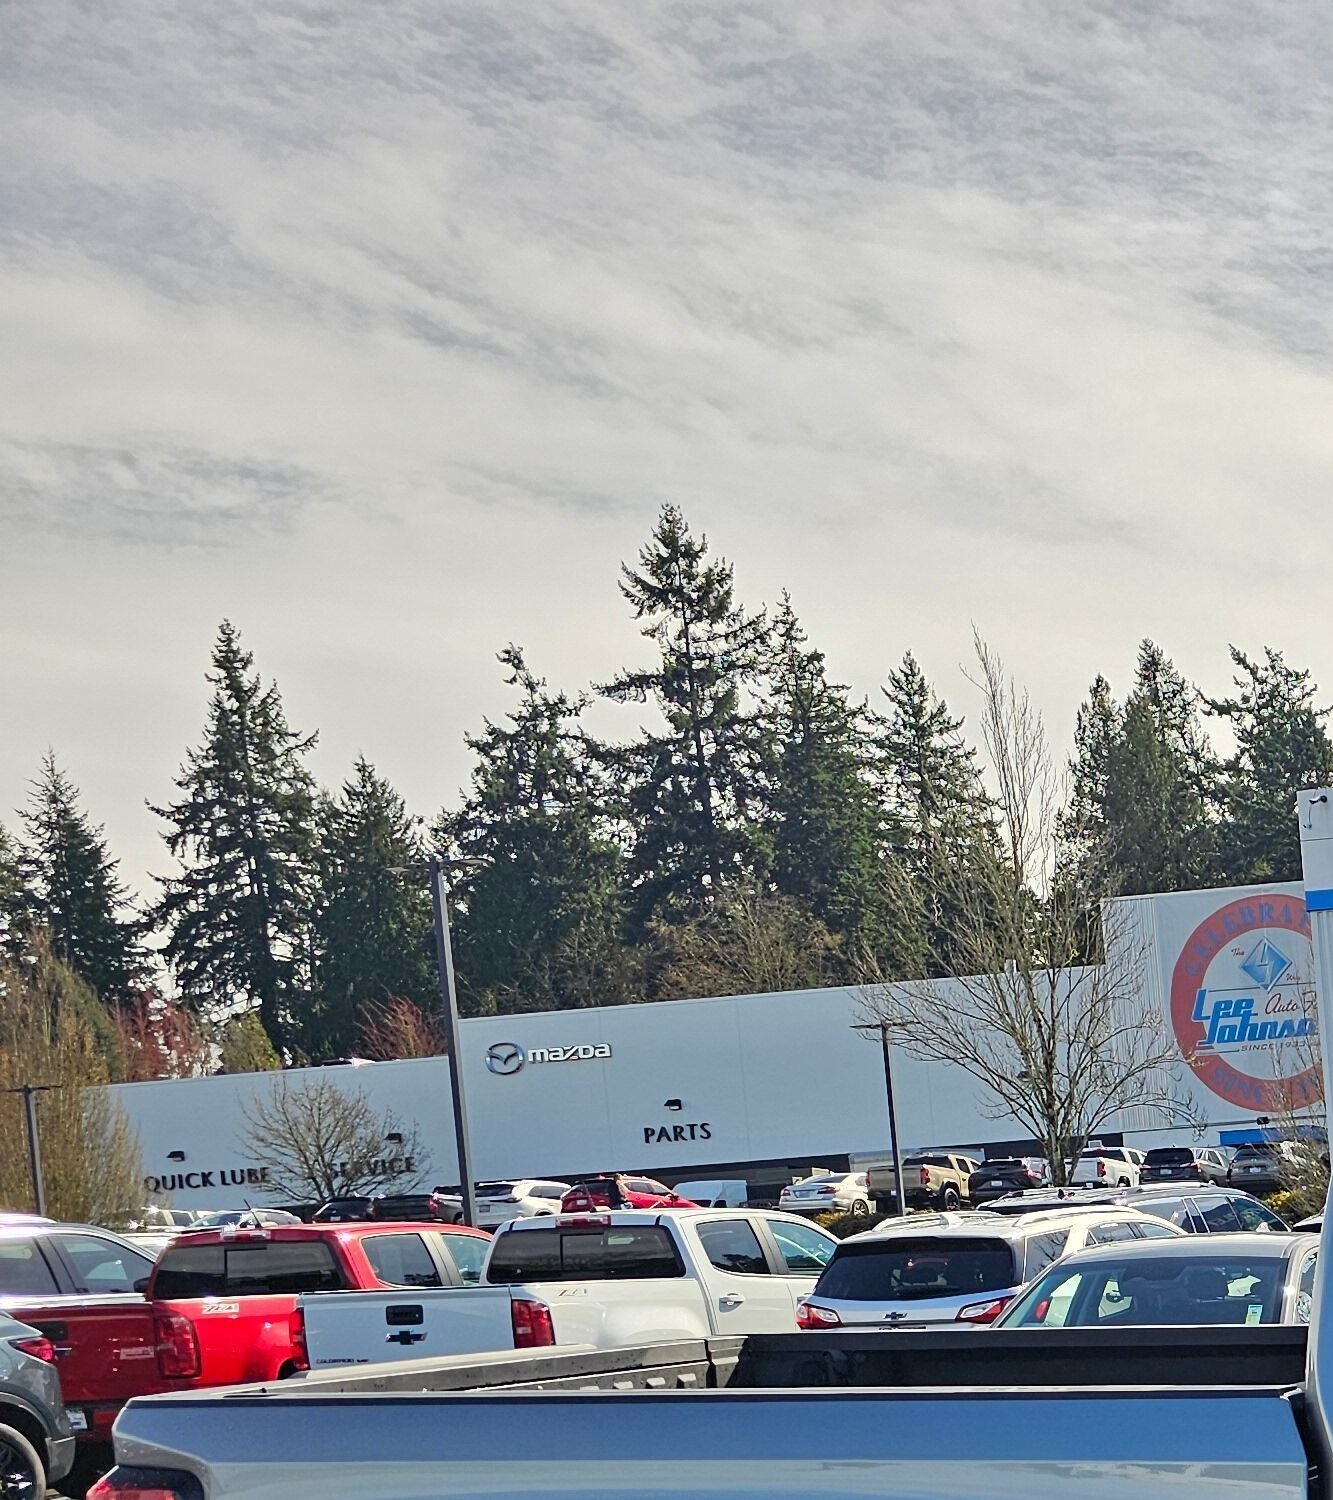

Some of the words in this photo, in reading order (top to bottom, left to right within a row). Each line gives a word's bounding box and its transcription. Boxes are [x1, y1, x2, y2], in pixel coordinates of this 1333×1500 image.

[1192, 988, 1259, 1022] Lee
[1264, 992, 1300, 1015] Auto
[1197, 1014, 1319, 1047] Johnso
[527, 1043, 613, 1064] mazda
[1240, 1042, 1274, 1052] SINCE
[643, 1122, 712, 1144] PARTS
[144, 1171, 215, 1194] QUICK
[219, 1167, 271, 1187] LUBE
